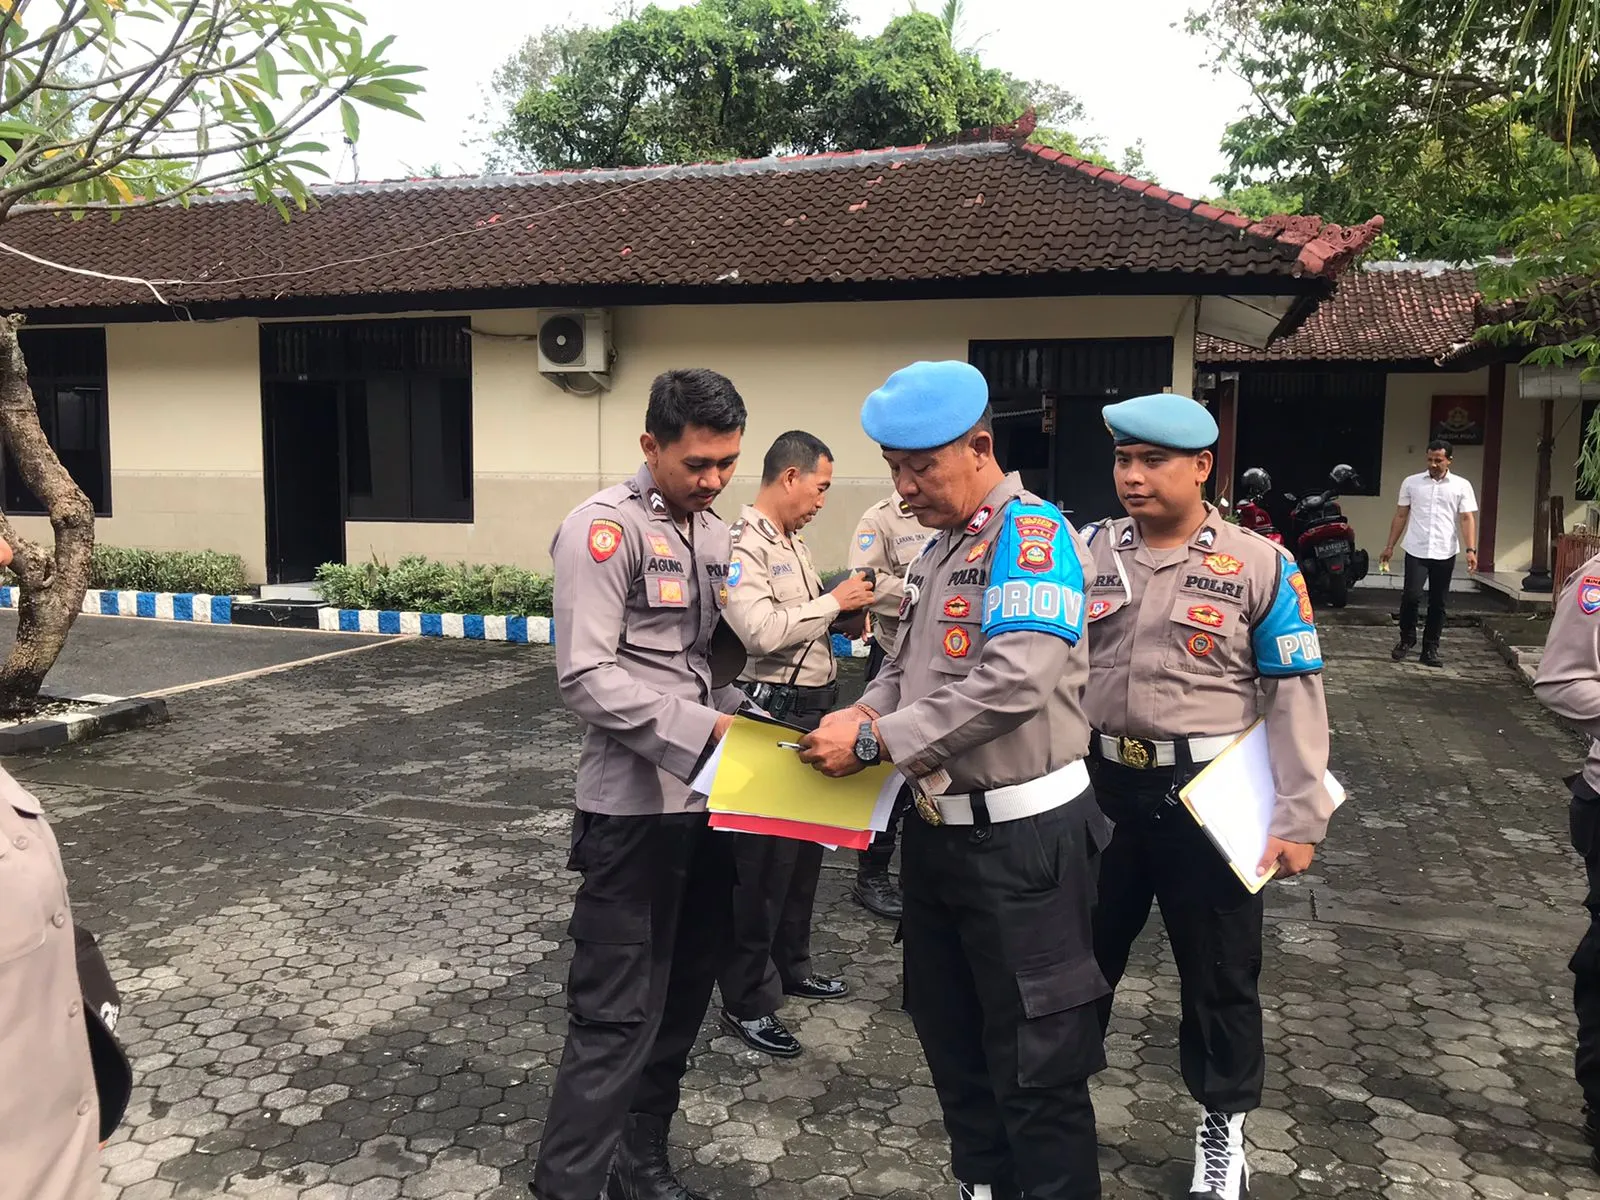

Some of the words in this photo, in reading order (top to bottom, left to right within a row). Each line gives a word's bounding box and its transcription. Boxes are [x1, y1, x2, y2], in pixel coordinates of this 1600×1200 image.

[647, 557, 684, 573] AGUNG
[947, 568, 987, 586] POLRI
[1184, 574, 1245, 599] POLRI
[983, 580, 1085, 627] PROV
